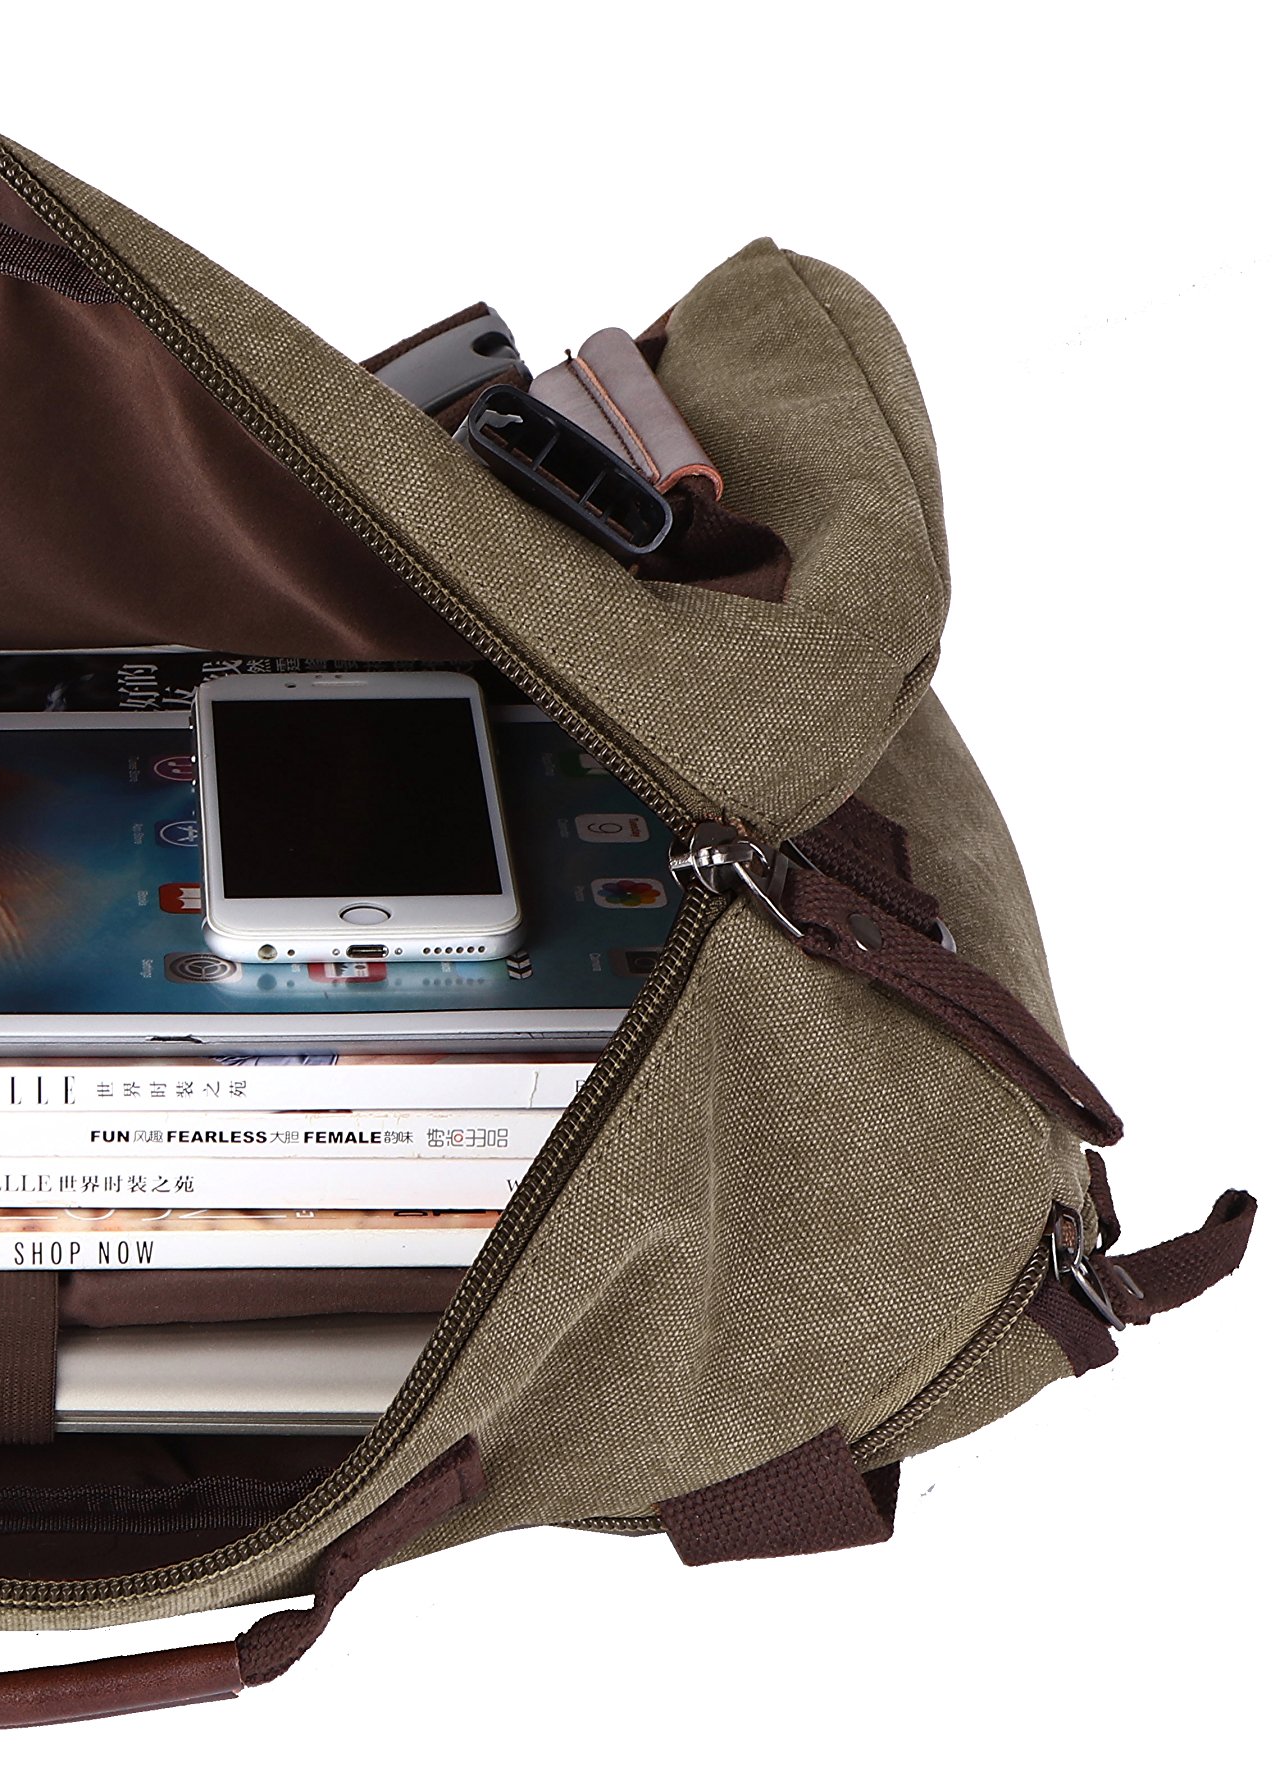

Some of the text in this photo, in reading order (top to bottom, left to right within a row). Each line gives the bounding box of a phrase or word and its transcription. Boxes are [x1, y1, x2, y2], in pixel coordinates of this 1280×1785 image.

[96, 1080, 248, 1099] 世界时装之苑
[90, 1129, 414, 1145] FUN 风趣 FEARLESS 大胆 FEMALE 韵味
[59, 1174, 195, 1194] 世界时装之苑
[14, 1241, 82, 1266] SHOP
[98, 1240, 155, 1265] NOW
